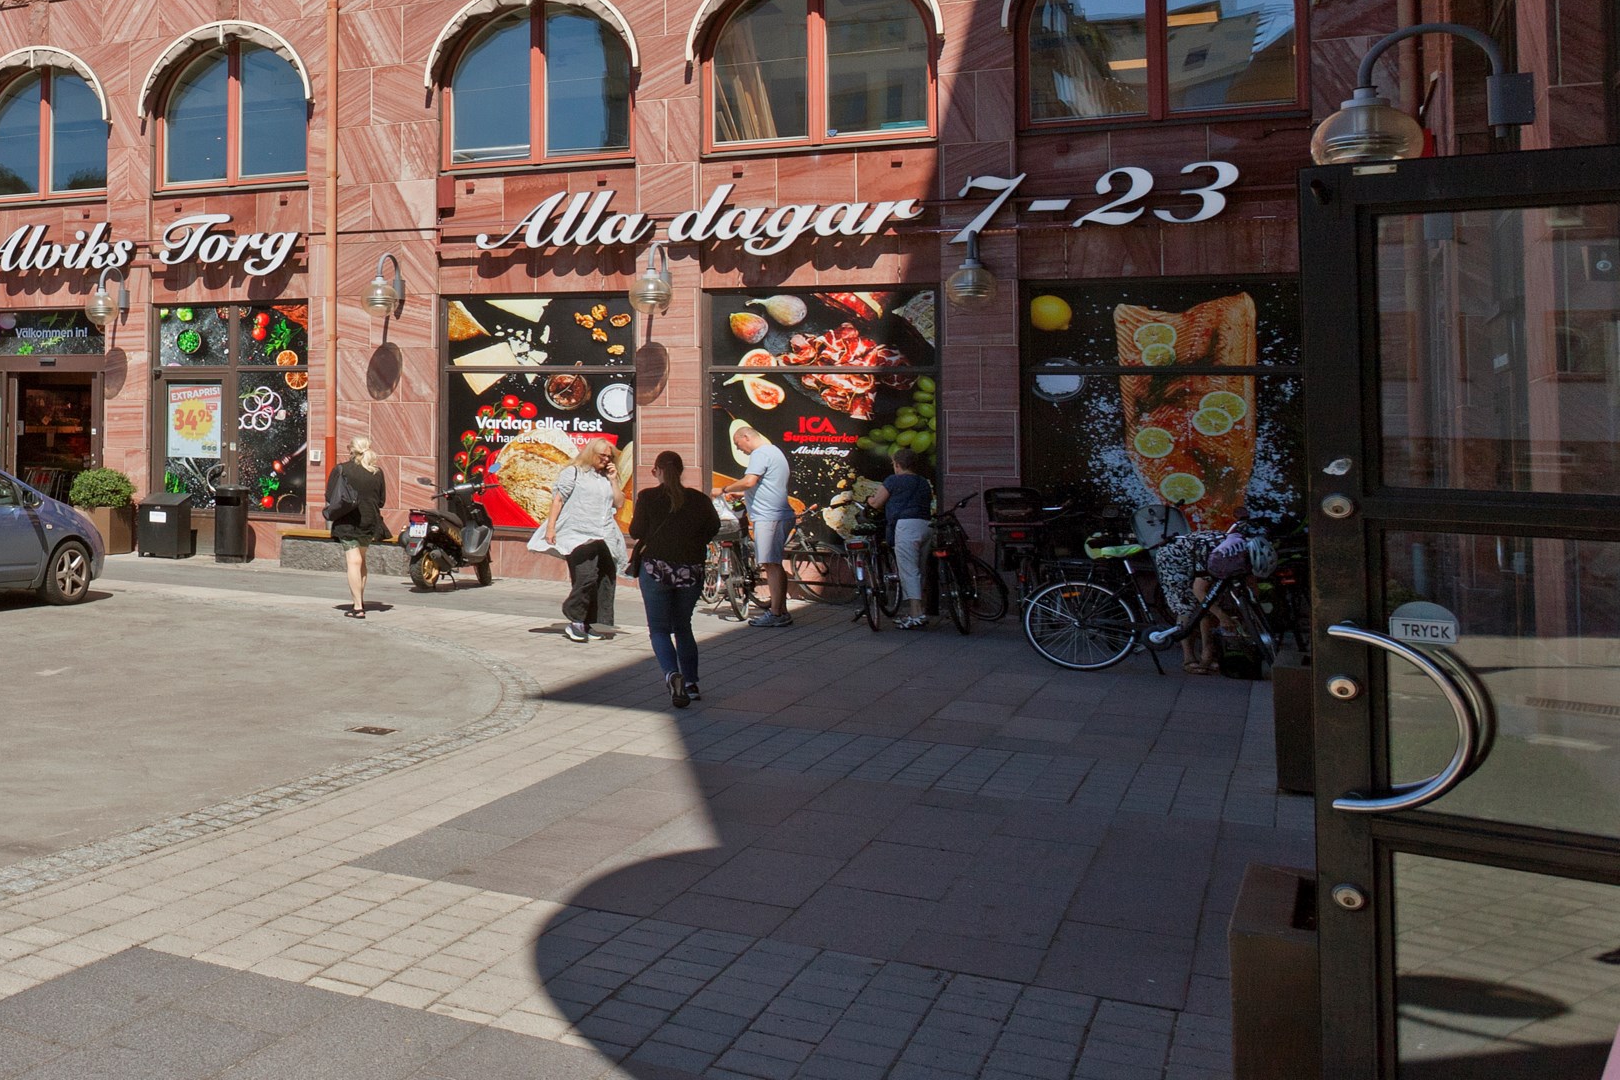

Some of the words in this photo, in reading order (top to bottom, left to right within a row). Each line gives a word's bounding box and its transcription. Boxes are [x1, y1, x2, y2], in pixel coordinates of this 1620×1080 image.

[947, 161, 1240, 245] 7-23
[476, 191, 654, 249] Alla
[667, 183, 924, 257] dagar
[159, 213, 299, 276] Torg
[15, 327, 74, 339] Välkommen
[75, 327, 88, 338] in!
[171, 386, 221, 401] EXTRAPRIS!
[475, 416, 532, 432] Vardag
[535, 418, 570, 432] eller
[573, 418, 603, 432] fest
[799, 416, 837, 434] ICA
[484, 434, 495, 443] vi
[496, 433, 515, 443] har
[518, 434, 537, 444] det
[791, 445, 826, 456] Alviks
[825, 446, 851, 458] Torg
[1401, 623, 1451, 639] TRYCK
